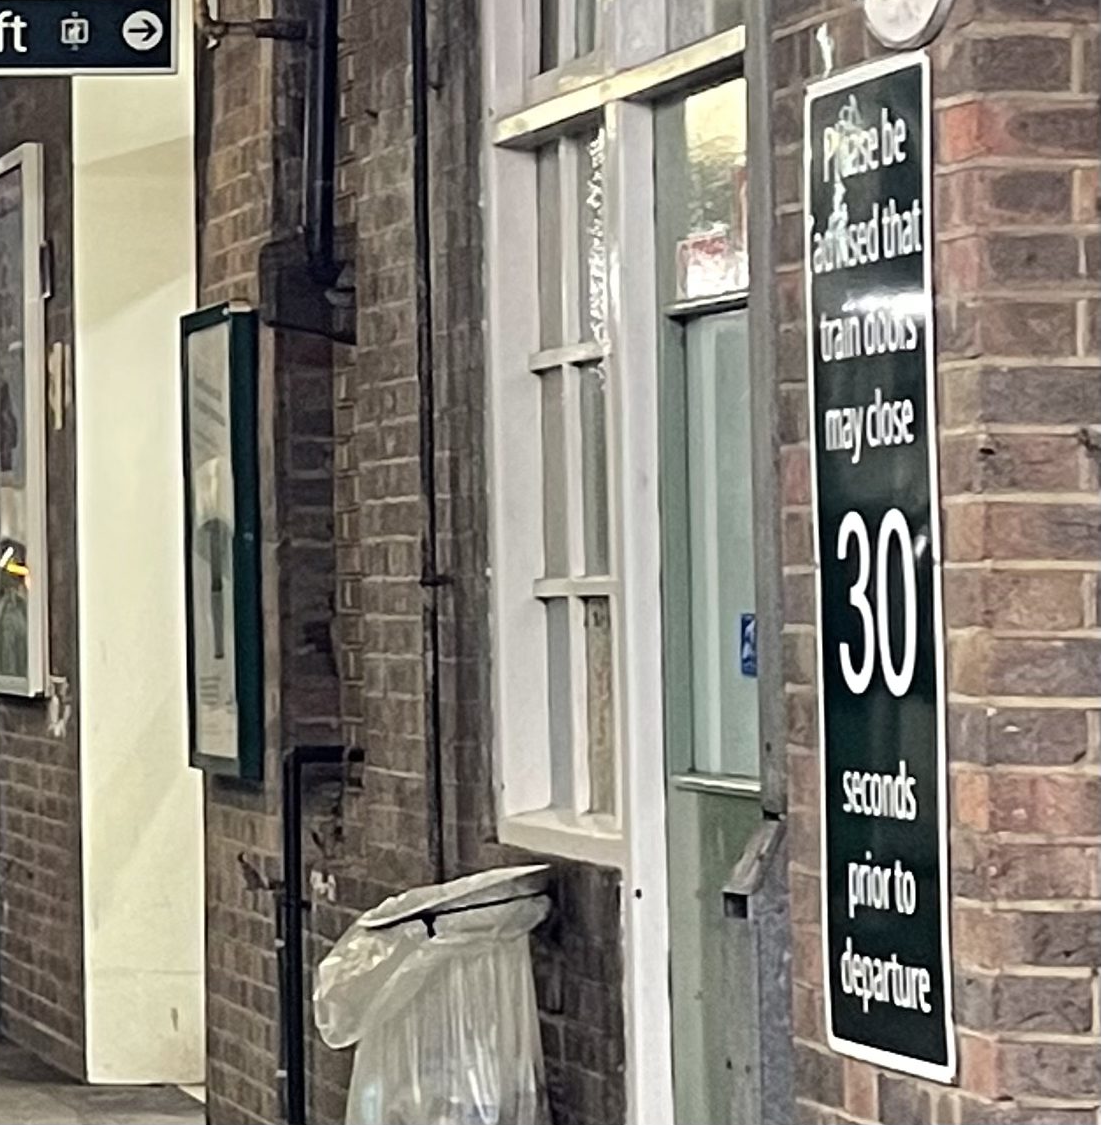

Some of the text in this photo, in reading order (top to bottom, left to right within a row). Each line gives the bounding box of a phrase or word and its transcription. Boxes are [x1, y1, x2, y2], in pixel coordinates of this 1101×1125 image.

[881, 108, 907, 165] be
[882, 198, 922, 260] that
[819, 312, 861, 362] train
[825, 387, 915, 464] may close
[836, 507, 918, 697] 30
[842, 759, 918, 821] seconds
[849, 850, 916, 919] prior to
[840, 936, 932, 1014] departure
